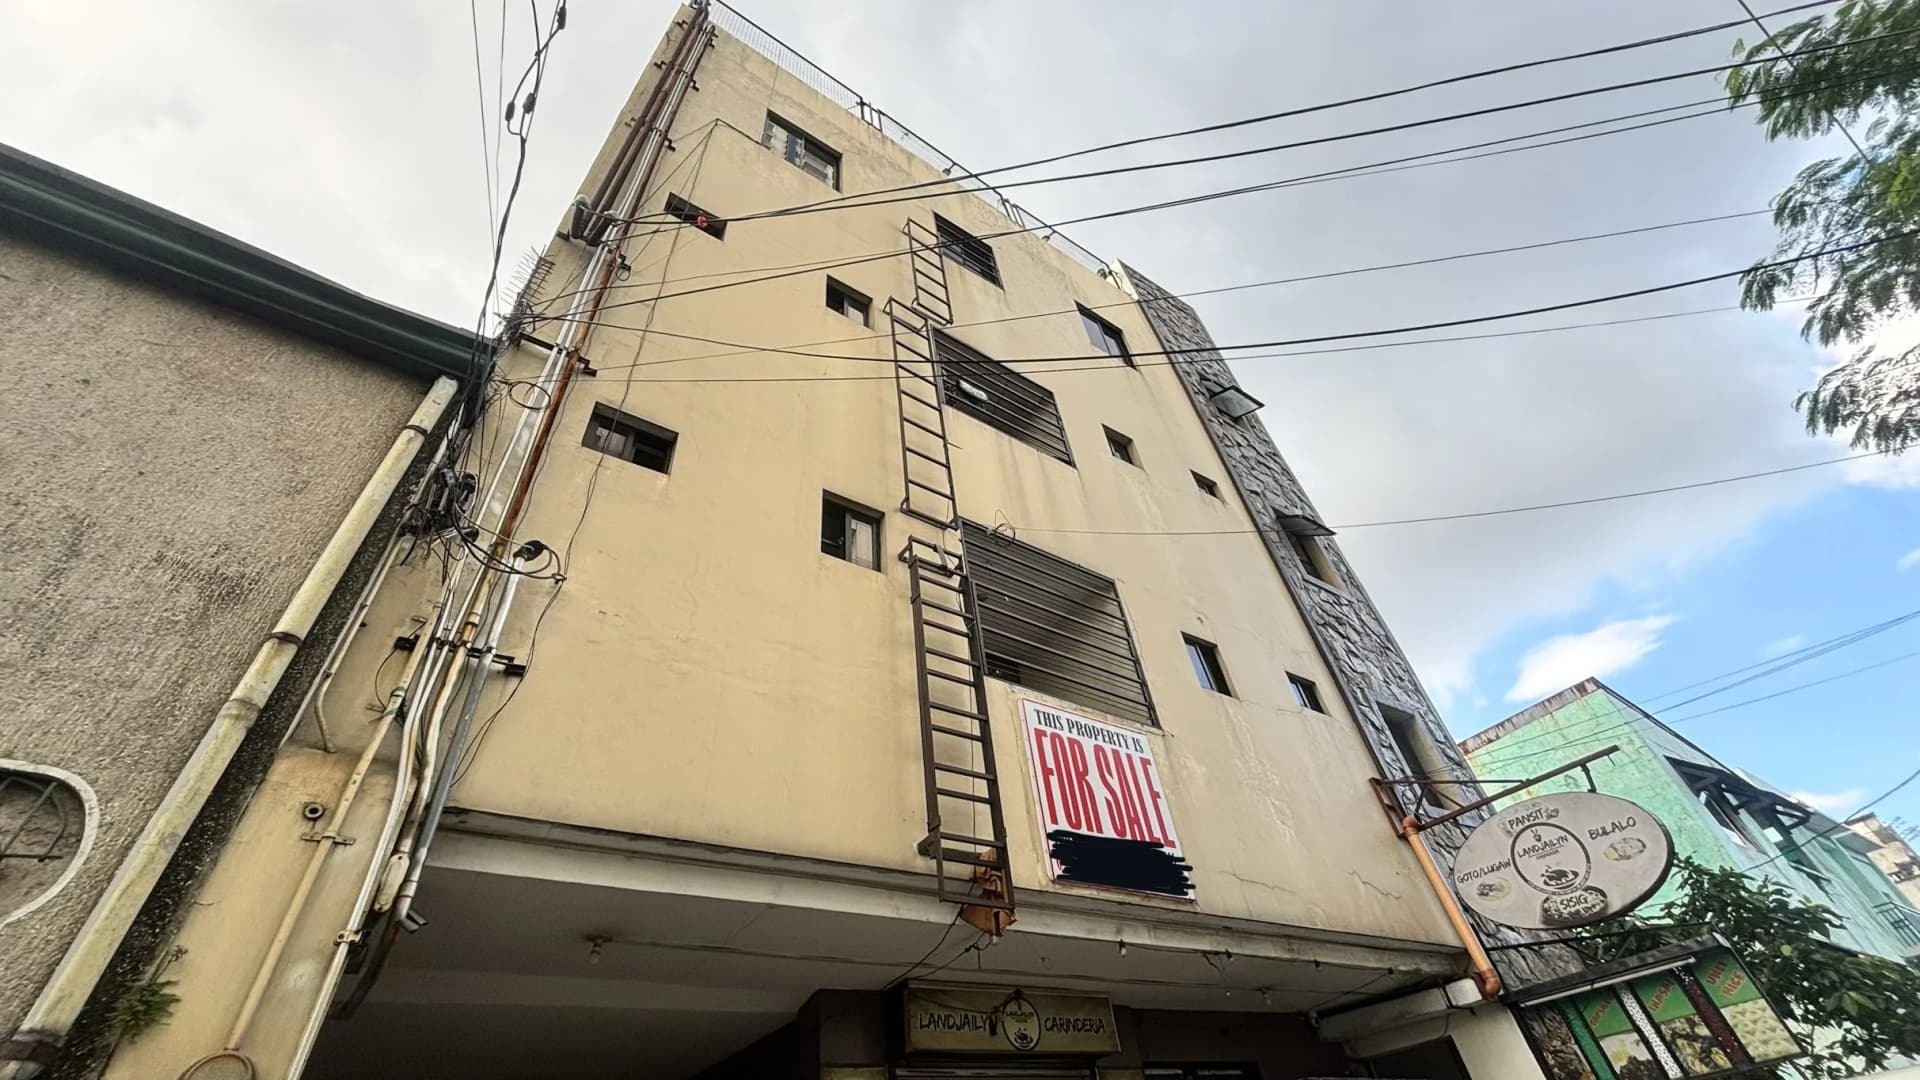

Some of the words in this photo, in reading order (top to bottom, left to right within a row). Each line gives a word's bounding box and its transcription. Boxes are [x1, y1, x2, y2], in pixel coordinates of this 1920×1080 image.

[1034, 708, 1063, 729] THIS
[1066, 717, 1130, 750] PROPERTY
[1131, 736, 1145, 753] IS
[1034, 727, 1104, 835] FOR
[1093, 743, 1177, 848] SALE
[1507, 807, 1544, 830] PANSIT
[1588, 816, 1637, 840] BULALO
[1517, 834, 1569, 858] LANDJAILYN
[1456, 858, 1513, 884] GOTO/LUGAW
[1559, 893, 1589, 910] SISIG
[1044, 1016, 1105, 1035] CARINDERIA
